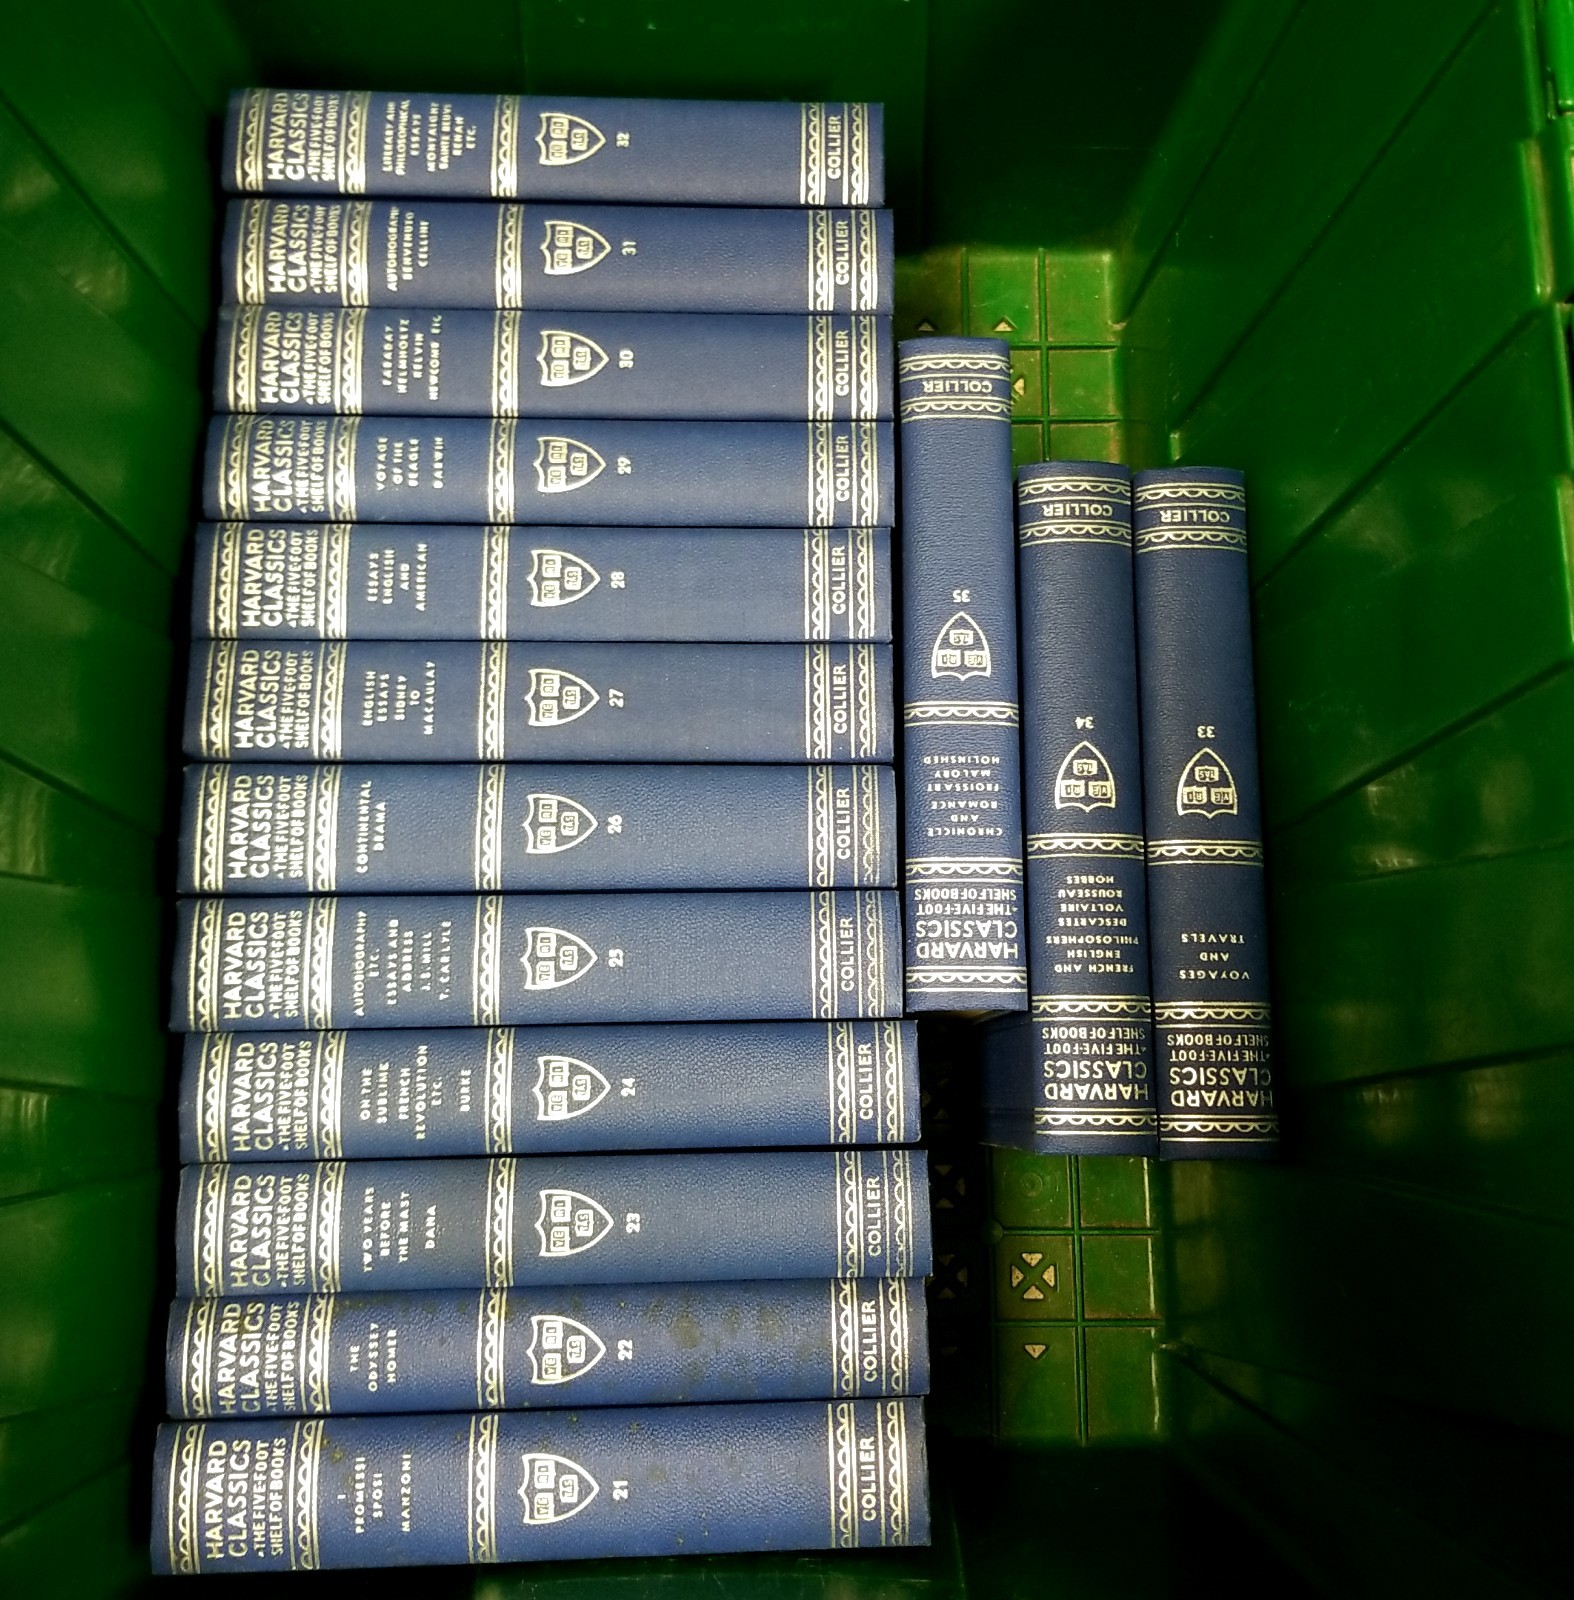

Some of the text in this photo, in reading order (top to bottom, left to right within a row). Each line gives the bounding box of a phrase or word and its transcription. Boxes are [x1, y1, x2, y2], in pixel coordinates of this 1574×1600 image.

[266, 92, 289, 180] HARVARD
[286, 93, 309, 181] CLASSICS
[410, 114, 422, 156] ESSAYS
[452, 116, 464, 156] RENAN
[617, 132, 630, 147] 32
[827, 115, 843, 179] COLLIER
[269, 204, 289, 292] HARVARD
[287, 204, 310, 292] CLASSICS
[402, 212, 414, 280] BENVENUTO
[418, 221, 429, 267] CELLINI
[622, 241, 636, 255] 31
[834, 221, 850, 285] COLLIER
[261, 312, 281, 403] HARVARD
[280, 312, 303, 403] CLASSICS
[382, 325, 394, 385] FARADAY
[397, 319, 409, 393] HELMHOLTZ
[412, 332, 424, 378] KELVIN
[619, 350, 634, 368] 30
[834, 330, 850, 396] COLLIER
[923, 380, 992, 394] COLLIER
[252, 420, 274, 512] HARVARD
[273, 420, 295, 512] CLASSICS
[376, 437, 388, 490] VOYAGE
[392, 442, 403, 484] OF THE
[408, 439, 419, 487] BEAGLE
[433, 437, 444, 489] DARWIN
[618, 457, 632, 474] 29
[834, 435, 850, 502] COLLIER
[1042, 503, 1113, 517] COLLIER
[1159, 509, 1230, 523] COLLIER
[242, 529, 264, 627] HARVARD
[263, 529, 286, 627] CLASSICS
[368, 552, 379, 602] ESSAYS
[382, 549, 394, 604] ENGLISH
[400, 563, 410, 590] AND
[416, 544, 427, 611] AMERICAN
[612, 571, 625, 589] 28
[831, 546, 847, 614] COLLIER
[952, 589, 970, 602] 35
[235, 650, 259, 748] HARVARD
[256, 650, 281, 748] CLASSICS
[363, 671, 376, 726] ENGLISH
[378, 674, 390, 721] ESSAYS
[395, 675, 406, 720] SIDNEY
[409, 691, 420, 706] TO
[424, 662, 435, 735] MACAULAY
[609, 689, 624, 707] 27
[832, 664, 848, 734] COLLIER
[1075, 716, 1094, 729] 34
[1197, 725, 1215, 738] 33
[923, 755, 1000, 764] HOLINSHED
[934, 769, 990, 778] MALORY
[926, 783, 999, 792] FROISSART
[930, 801, 997, 809] ROMANCE
[228, 775, 251, 878] HARVARD
[250, 775, 275, 878] CLASSICS
[357, 781, 372, 873] CONTINENTAL
[374, 802, 386, 851] DRAMA
[608, 815, 622, 834] 26
[836, 787, 851, 859] COLLIER
[927, 827, 1002, 836] CHRONICLE
[950, 814, 979, 822] AND
[1058, 889, 1122, 898] ROUSSEAU
[1066, 875, 1114, 884] HOBBES
[916, 920, 1017, 938] CLASSICS
[1058, 917, 1127, 926] DESCARTES
[1060, 903, 1124, 912] VOLTAIRE
[368, 949, 380, 977] ETC.
[387, 919, 399, 1005] ESSAYS AND
[402, 931, 414, 992] ADDRESS
[440, 920, 452, 983] CARLYLE
[609, 949, 623, 967] 25
[839, 917, 855, 991] COLLIER
[916, 942, 1018, 959] HARVARD
[1046, 935, 1138, 944] PHILOSOPHERS
[1067, 949, 1120, 958] ENGLISH
[1181, 933, 1244, 944] TRAVELS
[1199, 952, 1229, 961] AND
[223, 912, 246, 1019] HARVARD
[246, 912, 269, 1018] CLASSICS
[354, 911, 368, 1017] AUTOBIOGRAPHY
[1054, 964, 1134, 973] FRENCH AND
[1179, 969, 1250, 980] VOYAGES
[1042, 1027, 1145, 1039] SHELF OF BOOKS
[1116, 1044, 1140, 1055] THE
[1167, 1034, 1269, 1046] SHELF OF BOOKS
[1242, 1050, 1265, 1061] THE
[360, 1067, 372, 1121] ON THE
[377, 1063, 389, 1124] SUBLIME
[399, 1068, 410, 1120] FRENCH
[416, 1045, 428, 1139] REVOLUTION
[432, 1077, 442, 1105] ETC.
[460, 1069, 471, 1111] BURKE
[622, 1078, 636, 1097] 24
[857, 1043, 874, 1119] COLLIER
[1043, 1060, 1146, 1078] CLASSICS
[1044, 1082, 1148, 1100] HARVARD
[1170, 1066, 1270, 1086] CLASSICS
[232, 1042, 255, 1151] HARVARD
[254, 1042, 278, 1151] CLASSICS
[1170, 1090, 1272, 1107] HARVARD
[230, 1175, 251, 1287] HARVARD
[252, 1175, 274, 1287] CLASSICS
[363, 1188, 374, 1272] TWO YEARS
[380, 1201, 391, 1256] BEFORE
[398, 1192, 410, 1263] THE MAST
[425, 1205, 436, 1249] DANA
[626, 1213, 641, 1233] 23
[865, 1176, 883, 1257] COLLIER
[218, 1304, 242, 1413] HARVARD
[240, 1303, 265, 1412] CLASSICS
[350, 1345, 360, 1372] THE
[368, 1323, 379, 1392] ODYSSEY
[387, 1329, 397, 1383] HOMER
[618, 1339, 633, 1360] 22
[861, 1300, 878, 1382] COLLIER
[206, 1441, 227, 1558] HARVARD
[228, 1440, 251, 1557] CLASSICS
[270, 1438, 286, 1556] SHELF OF BOOKS
[355, 1457, 366, 1533] PROMESSI
[372, 1473, 383, 1518] SPOSI
[401, 1454, 411, 1532] MANZONI
[613, 1480, 627, 1500] 21
[860, 1436, 877, 1521] COLLIER
[254, 1521, 266, 1549] THE
